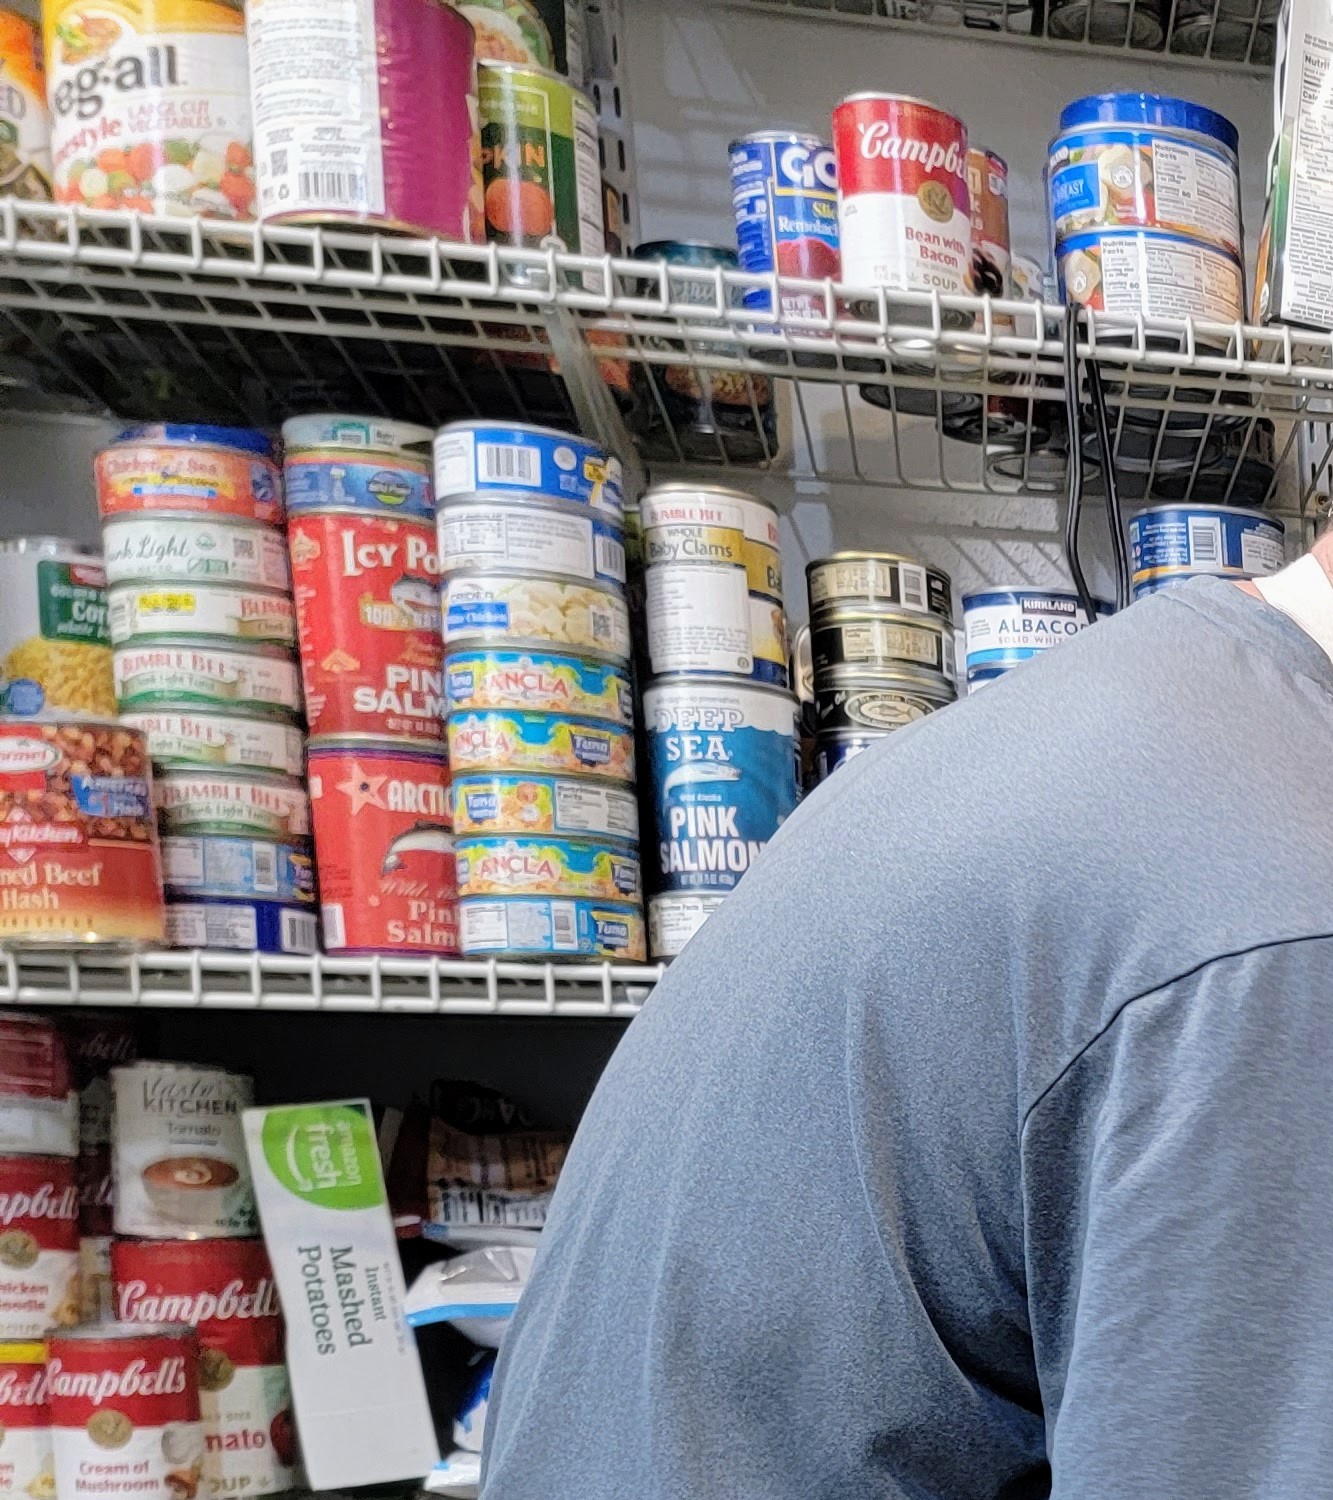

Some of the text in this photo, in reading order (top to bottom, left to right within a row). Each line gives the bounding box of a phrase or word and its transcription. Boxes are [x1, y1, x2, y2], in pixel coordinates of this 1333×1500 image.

[905, 226, 941, 246] Bean
[919, 244, 960, 269] Bacon
[922, 273, 959, 292] SOUP
[682, 535, 734, 560] Clams
[1023, 600, 1075, 613] KIRKLAND
[655, 707, 746, 733] DEEP
[665, 736, 731, 762] SEA
[670, 806, 740, 838] PINK
[304, 1122, 343, 1190] fresh
[298, 1244, 336, 1357] Potatoes
[330, 1245, 374, 1349] Mashed
[365, 1266, 387, 1322] Instant
